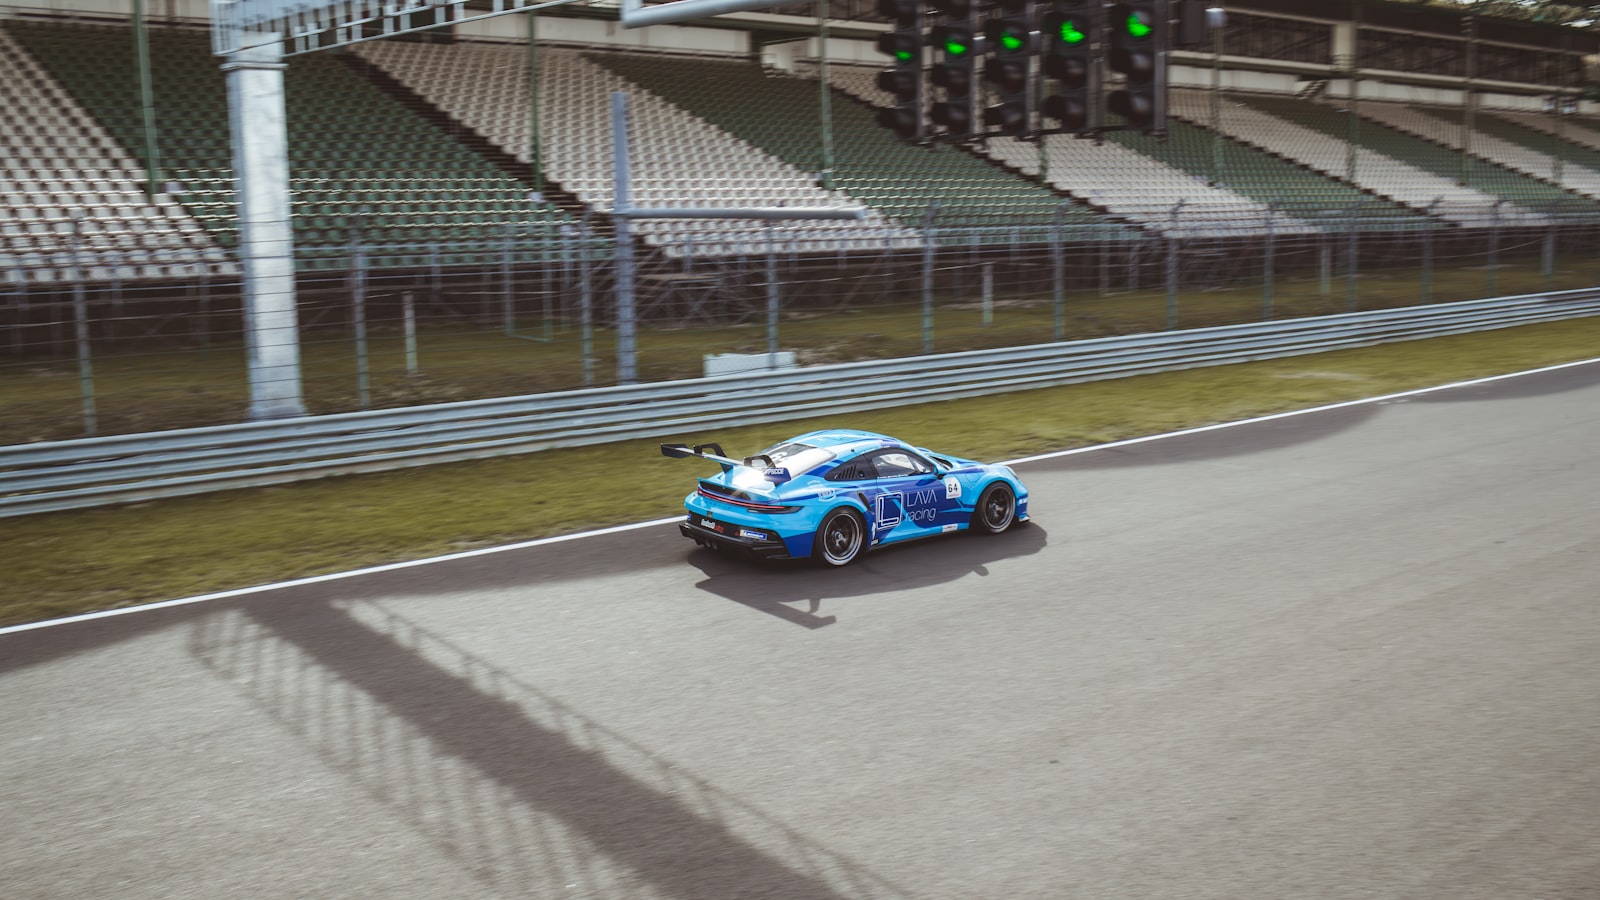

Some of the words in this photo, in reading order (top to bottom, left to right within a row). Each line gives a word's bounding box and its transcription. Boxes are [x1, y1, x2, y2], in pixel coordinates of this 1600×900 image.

[947, 483, 958, 493] 64
[906, 489, 937, 507] LAVA
[905, 508, 937, 522] racing
